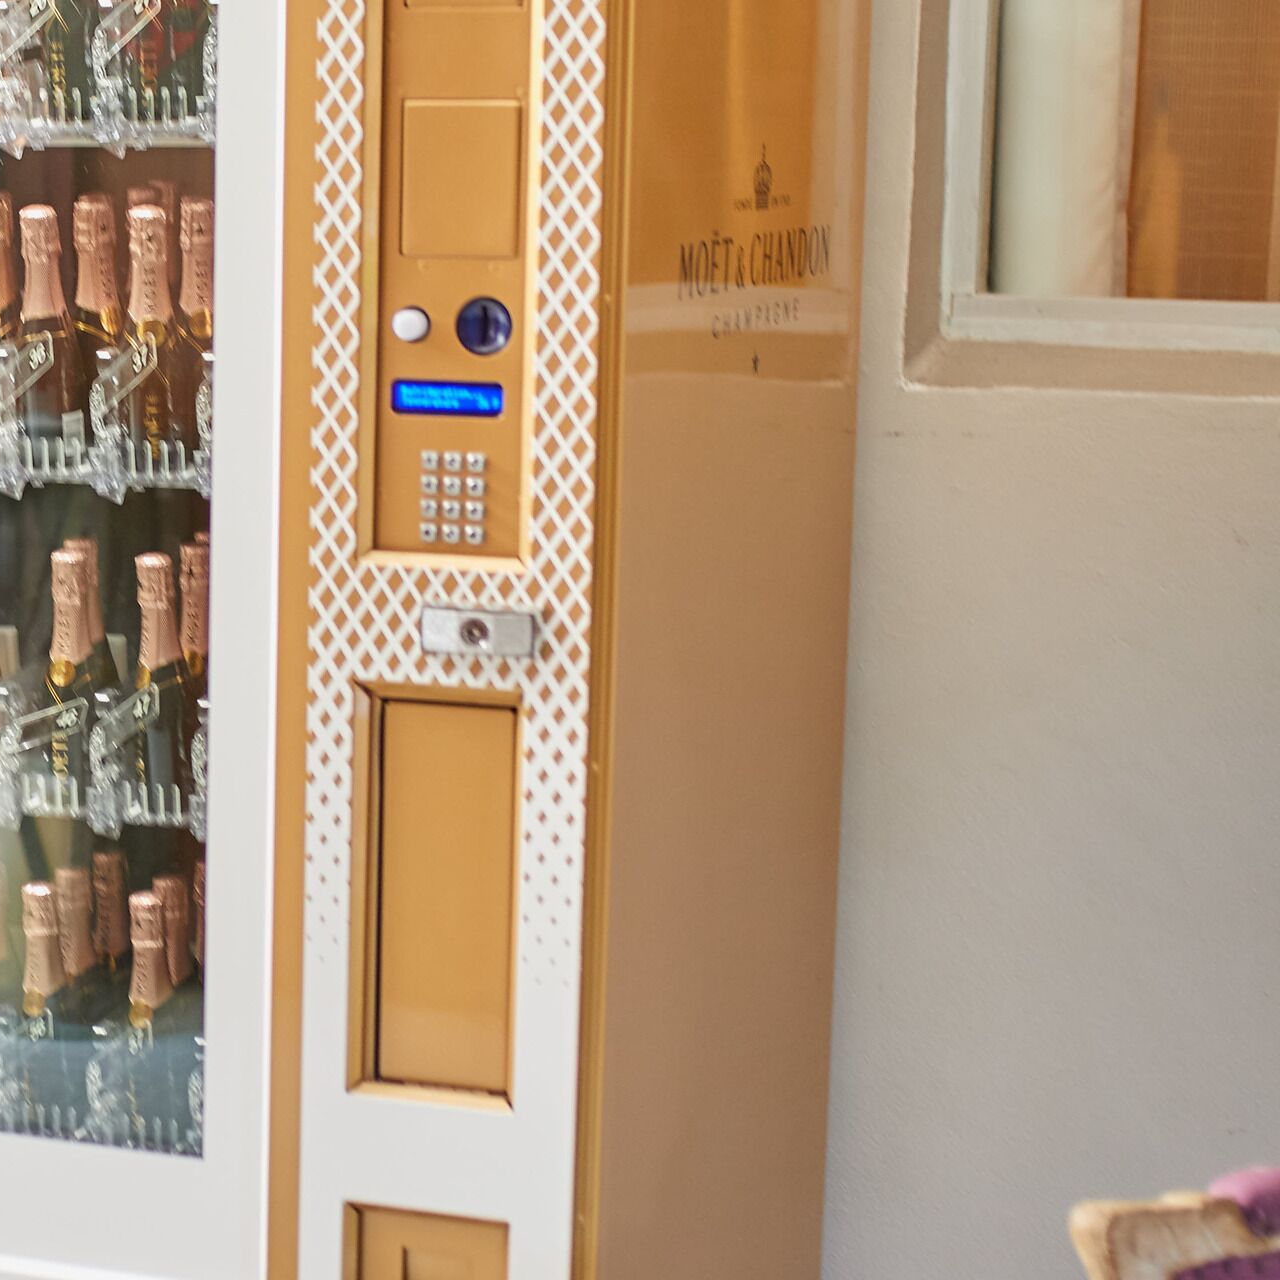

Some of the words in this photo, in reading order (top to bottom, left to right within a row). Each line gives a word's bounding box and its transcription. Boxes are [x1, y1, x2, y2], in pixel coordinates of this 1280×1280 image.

[677, 230, 734, 301] MOËT
[735, 246, 745, 289] &
[749, 224, 831, 287] CHANDON
[711, 298, 800, 339] CHAMPAGNE
